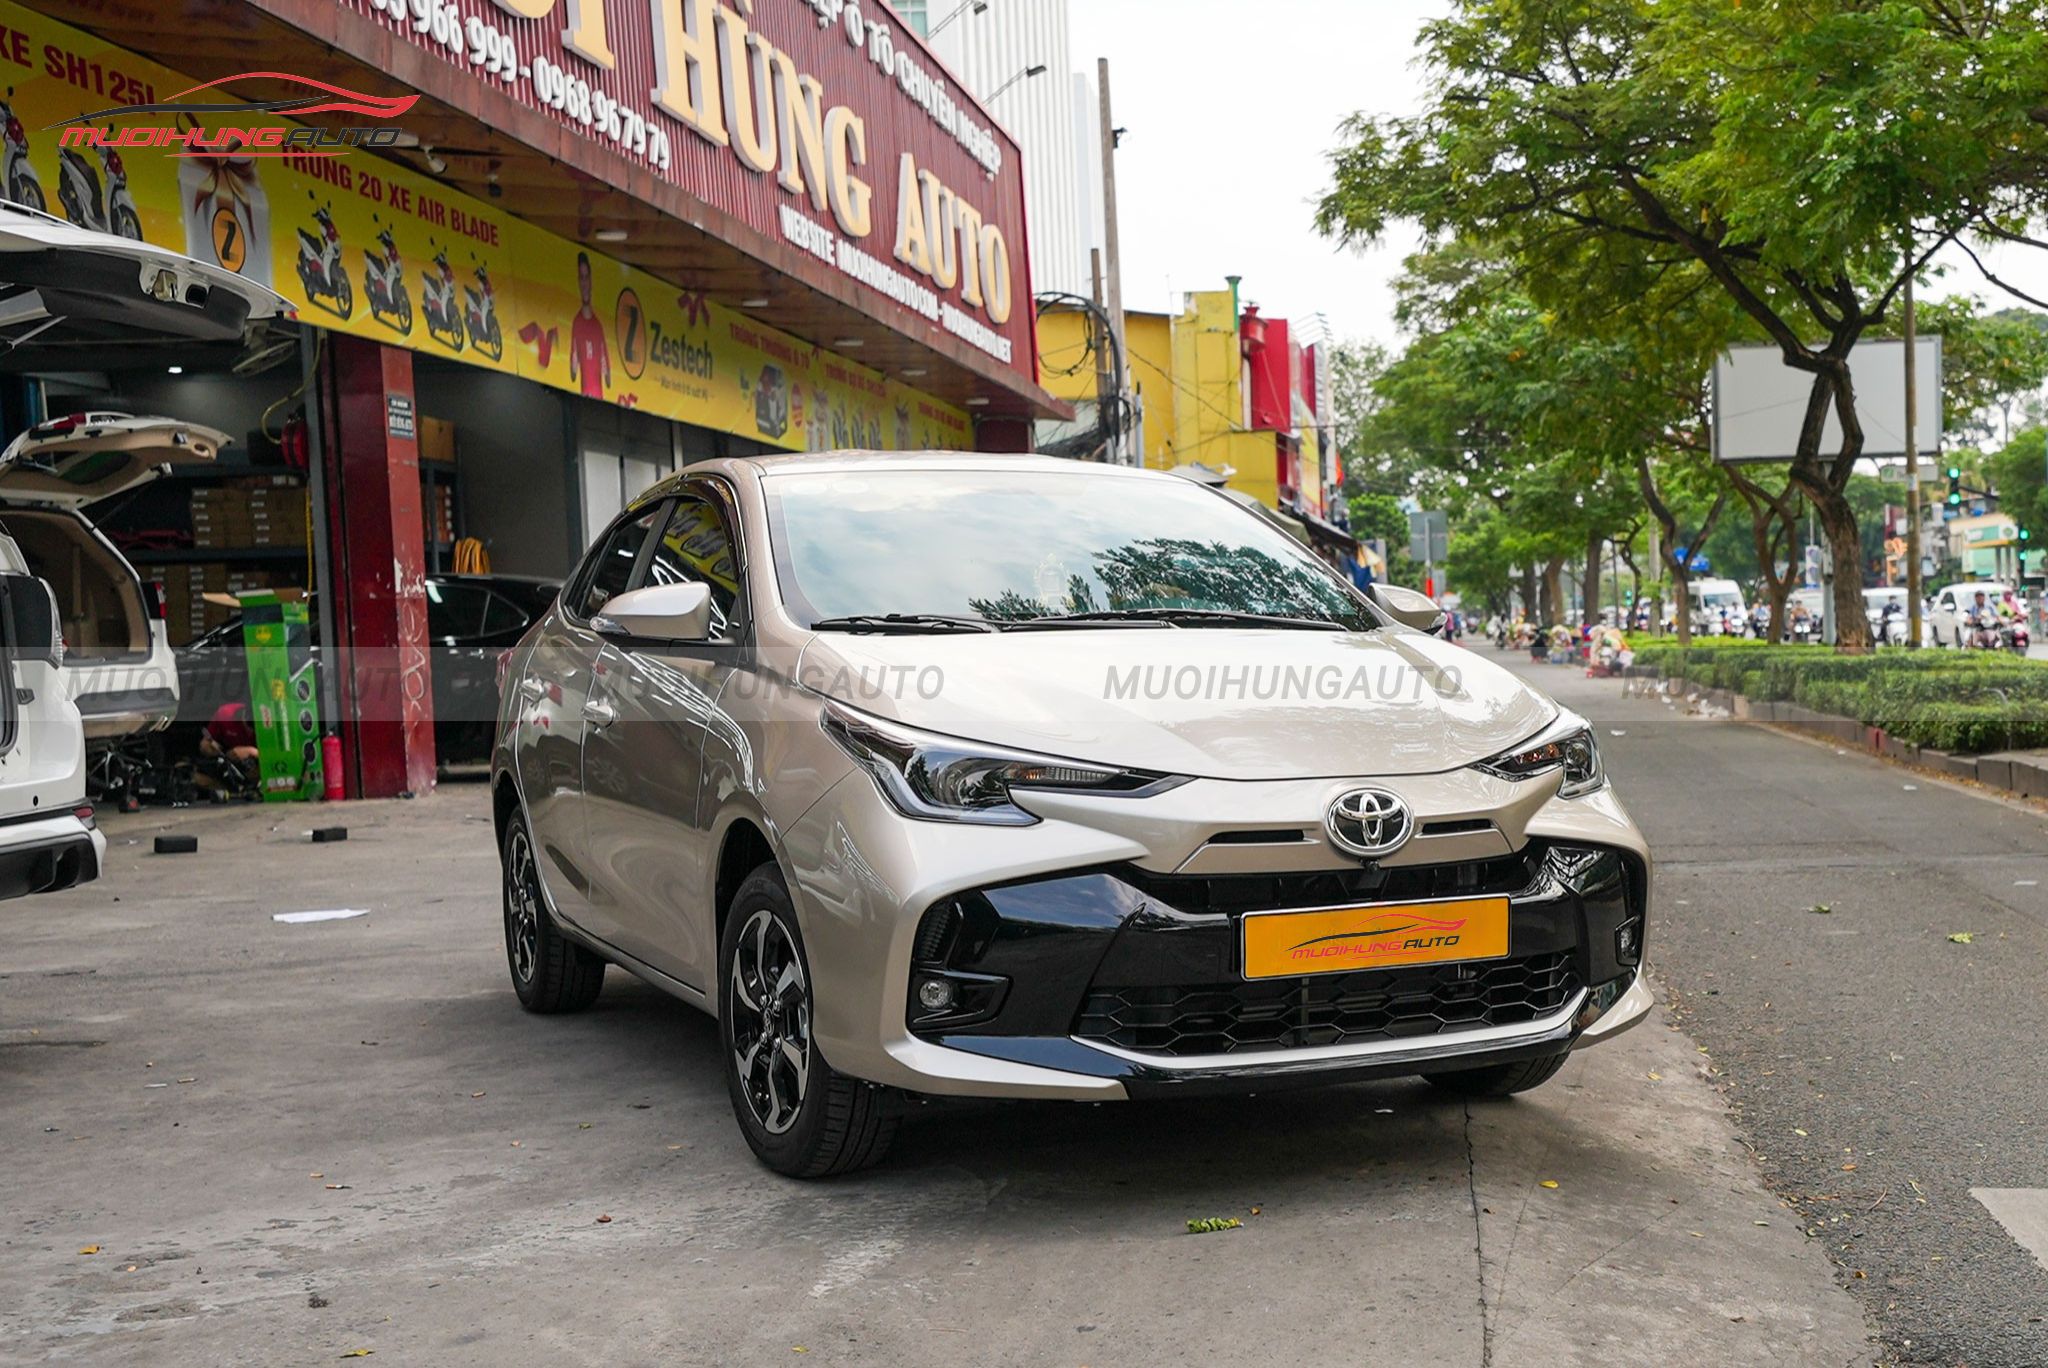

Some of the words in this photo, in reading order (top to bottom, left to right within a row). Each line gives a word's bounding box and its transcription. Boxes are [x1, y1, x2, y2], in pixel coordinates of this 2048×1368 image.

[533, 55, 592, 126] 0968
[864, 20, 895, 75] TÔ
[895, 51, 956, 137] CHUYÊN
[358, 171, 383, 201] 20
[388, 182, 412, 214] XE
[418, 195, 446, 227] AIR
[451, 208, 499, 247] BLADE
[893, 152, 1011, 324] AUTO
[650, 320, 714, 380] Zestech
